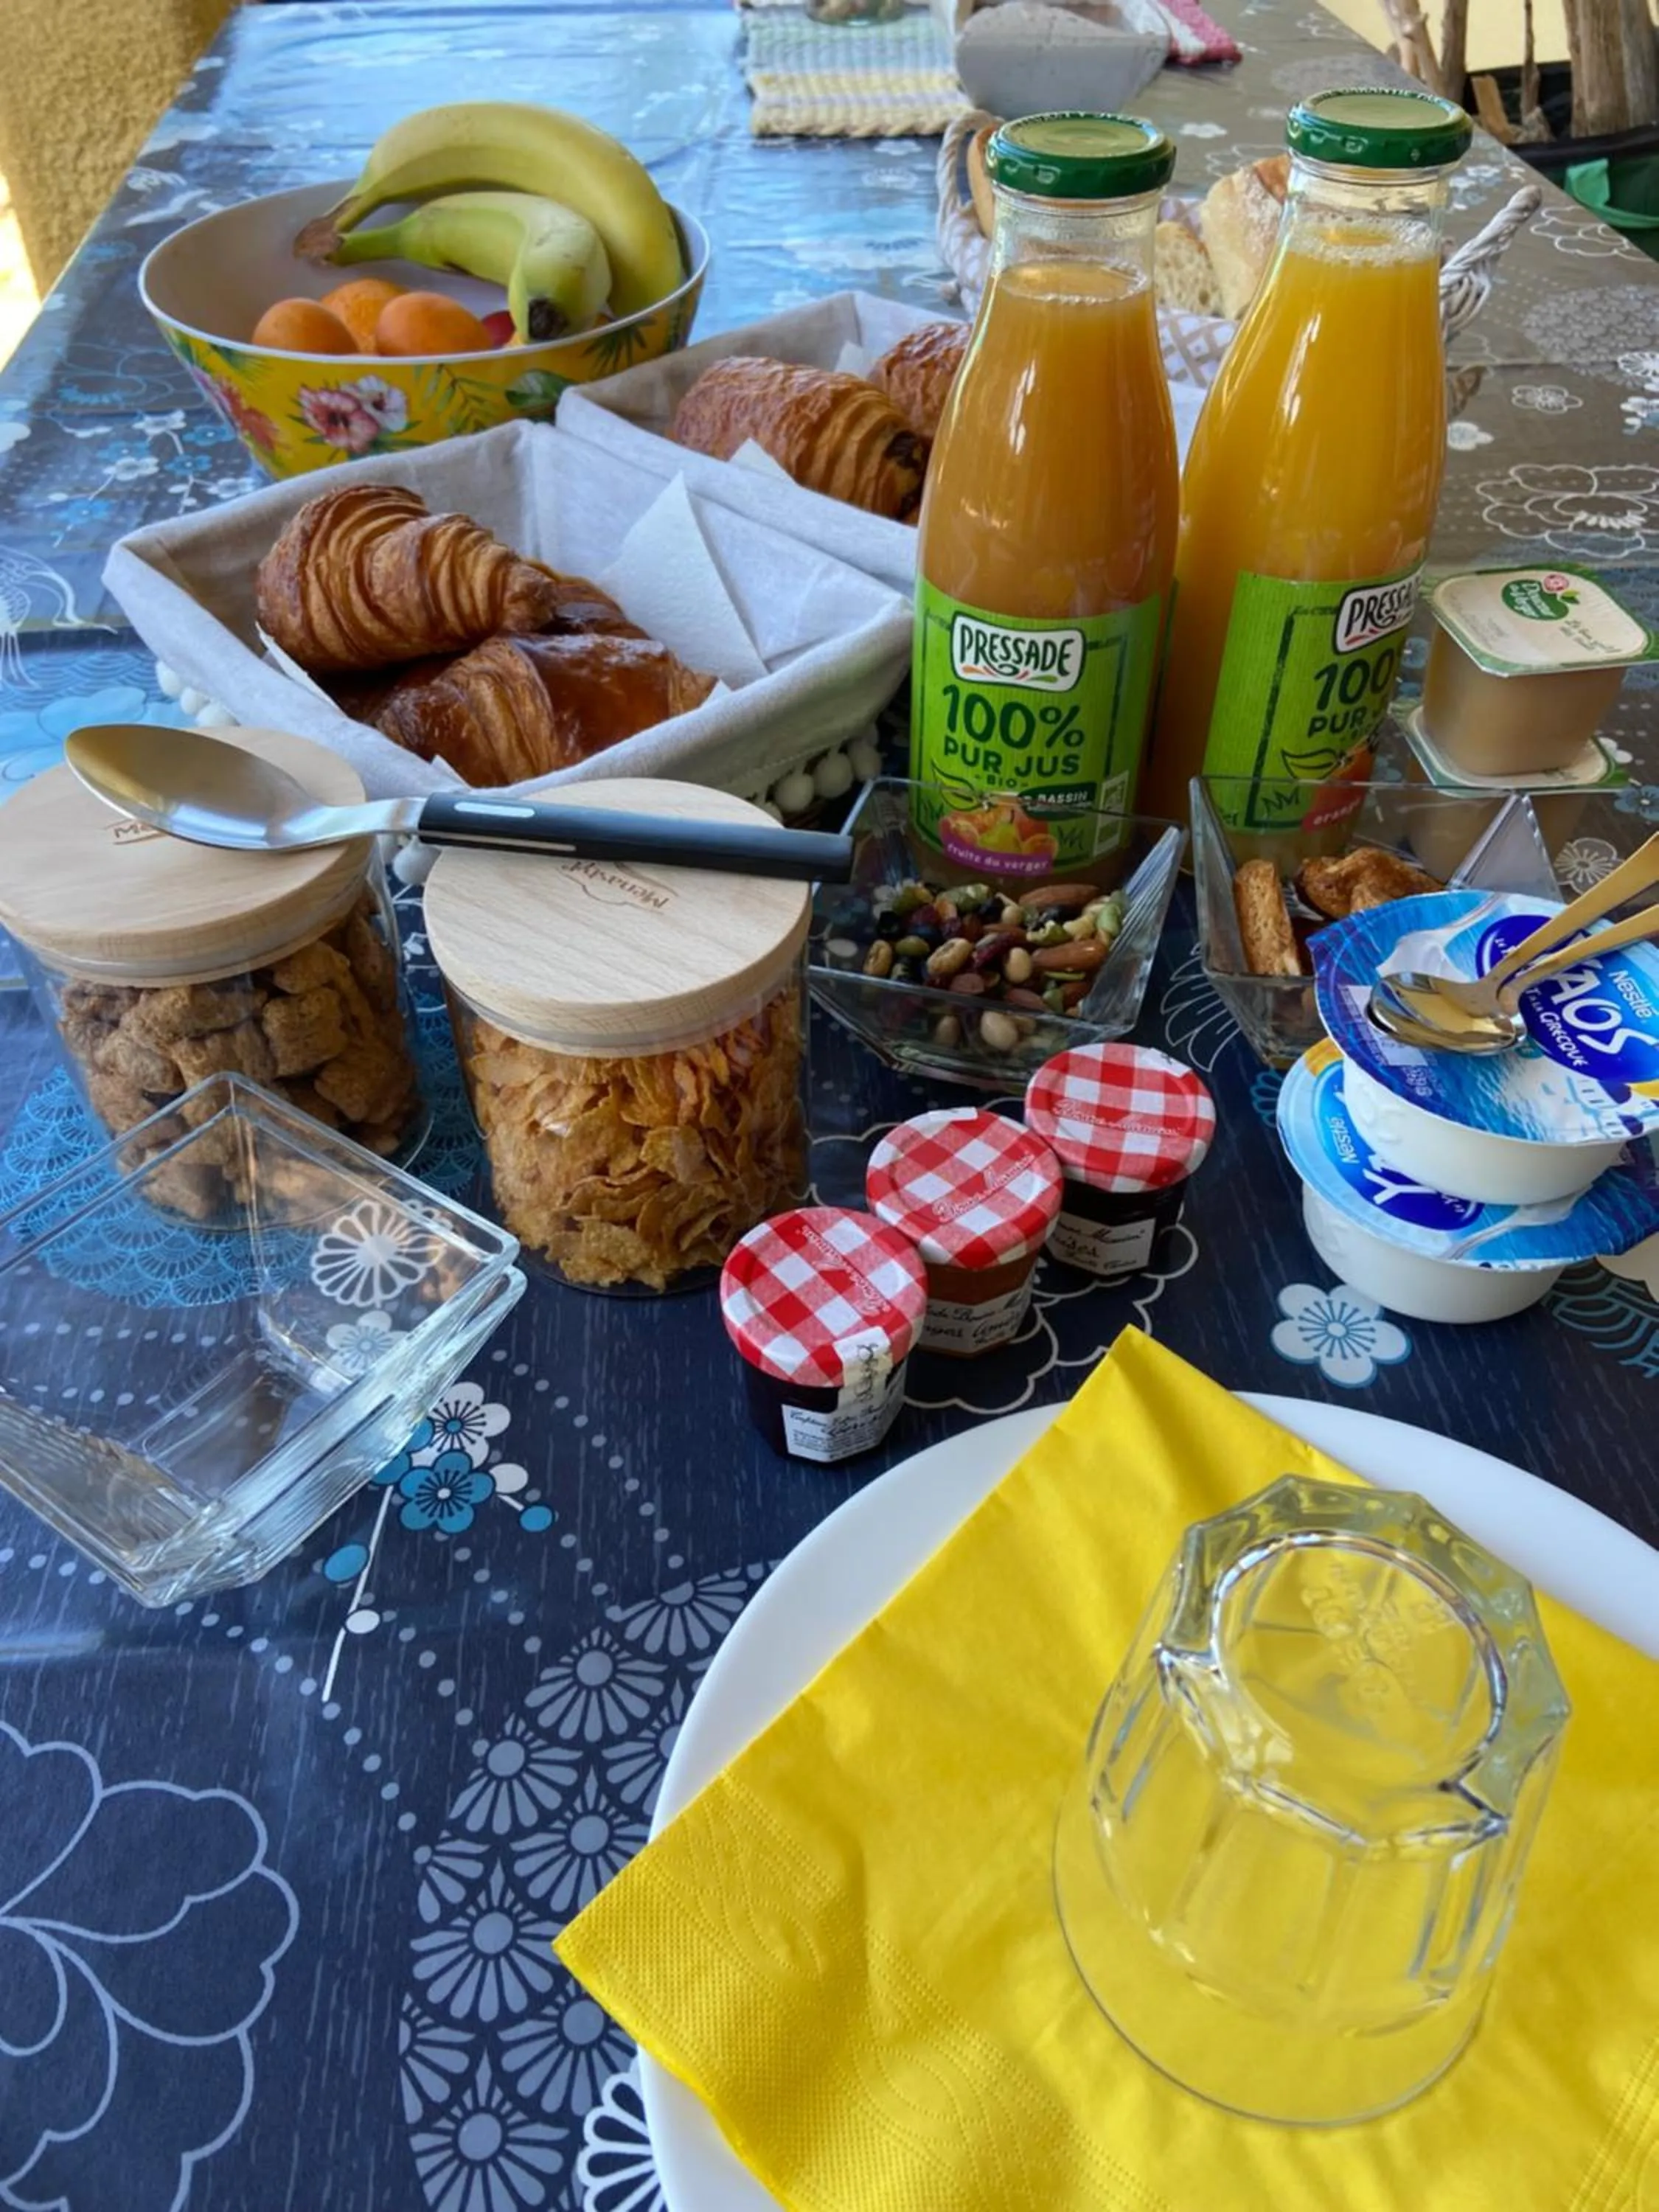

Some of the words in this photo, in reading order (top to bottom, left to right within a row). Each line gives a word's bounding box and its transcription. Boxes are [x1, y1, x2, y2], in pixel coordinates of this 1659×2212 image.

[961, 624, 1074, 676] PRESSADE
[943, 684, 1085, 749] 100%
[1308, 706, 1368, 738] PUR
[944, 737, 1003, 774] PUR
[1014, 754, 1080, 779] JUS
[947, 843, 981, 863] fruits
[984, 856, 1001, 868] du
[1004, 860, 1048, 872] verger
